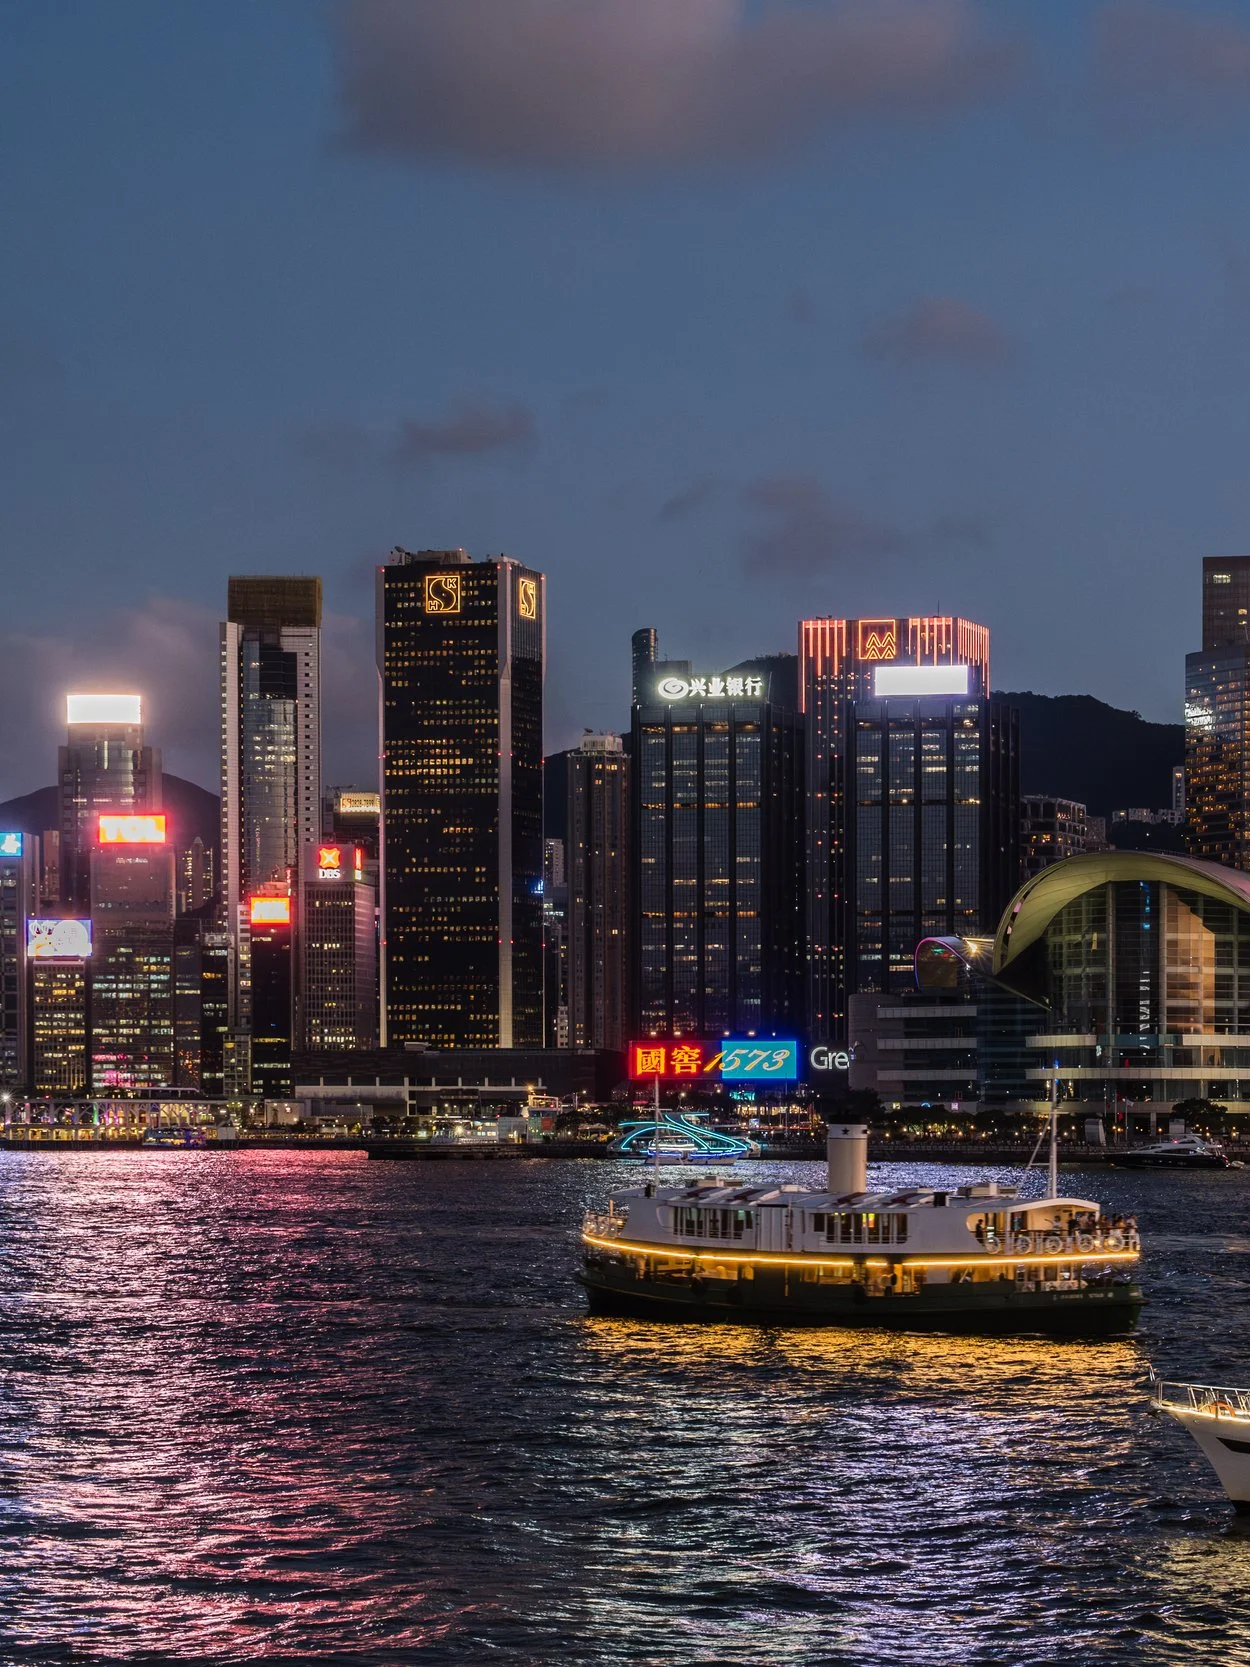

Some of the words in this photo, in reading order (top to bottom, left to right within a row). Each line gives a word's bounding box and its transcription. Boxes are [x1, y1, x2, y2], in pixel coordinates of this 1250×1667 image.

[689, 677, 762, 696] 兴业银行
[319, 869, 341, 879] DBS
[810, 1046, 850, 1070] Gre
